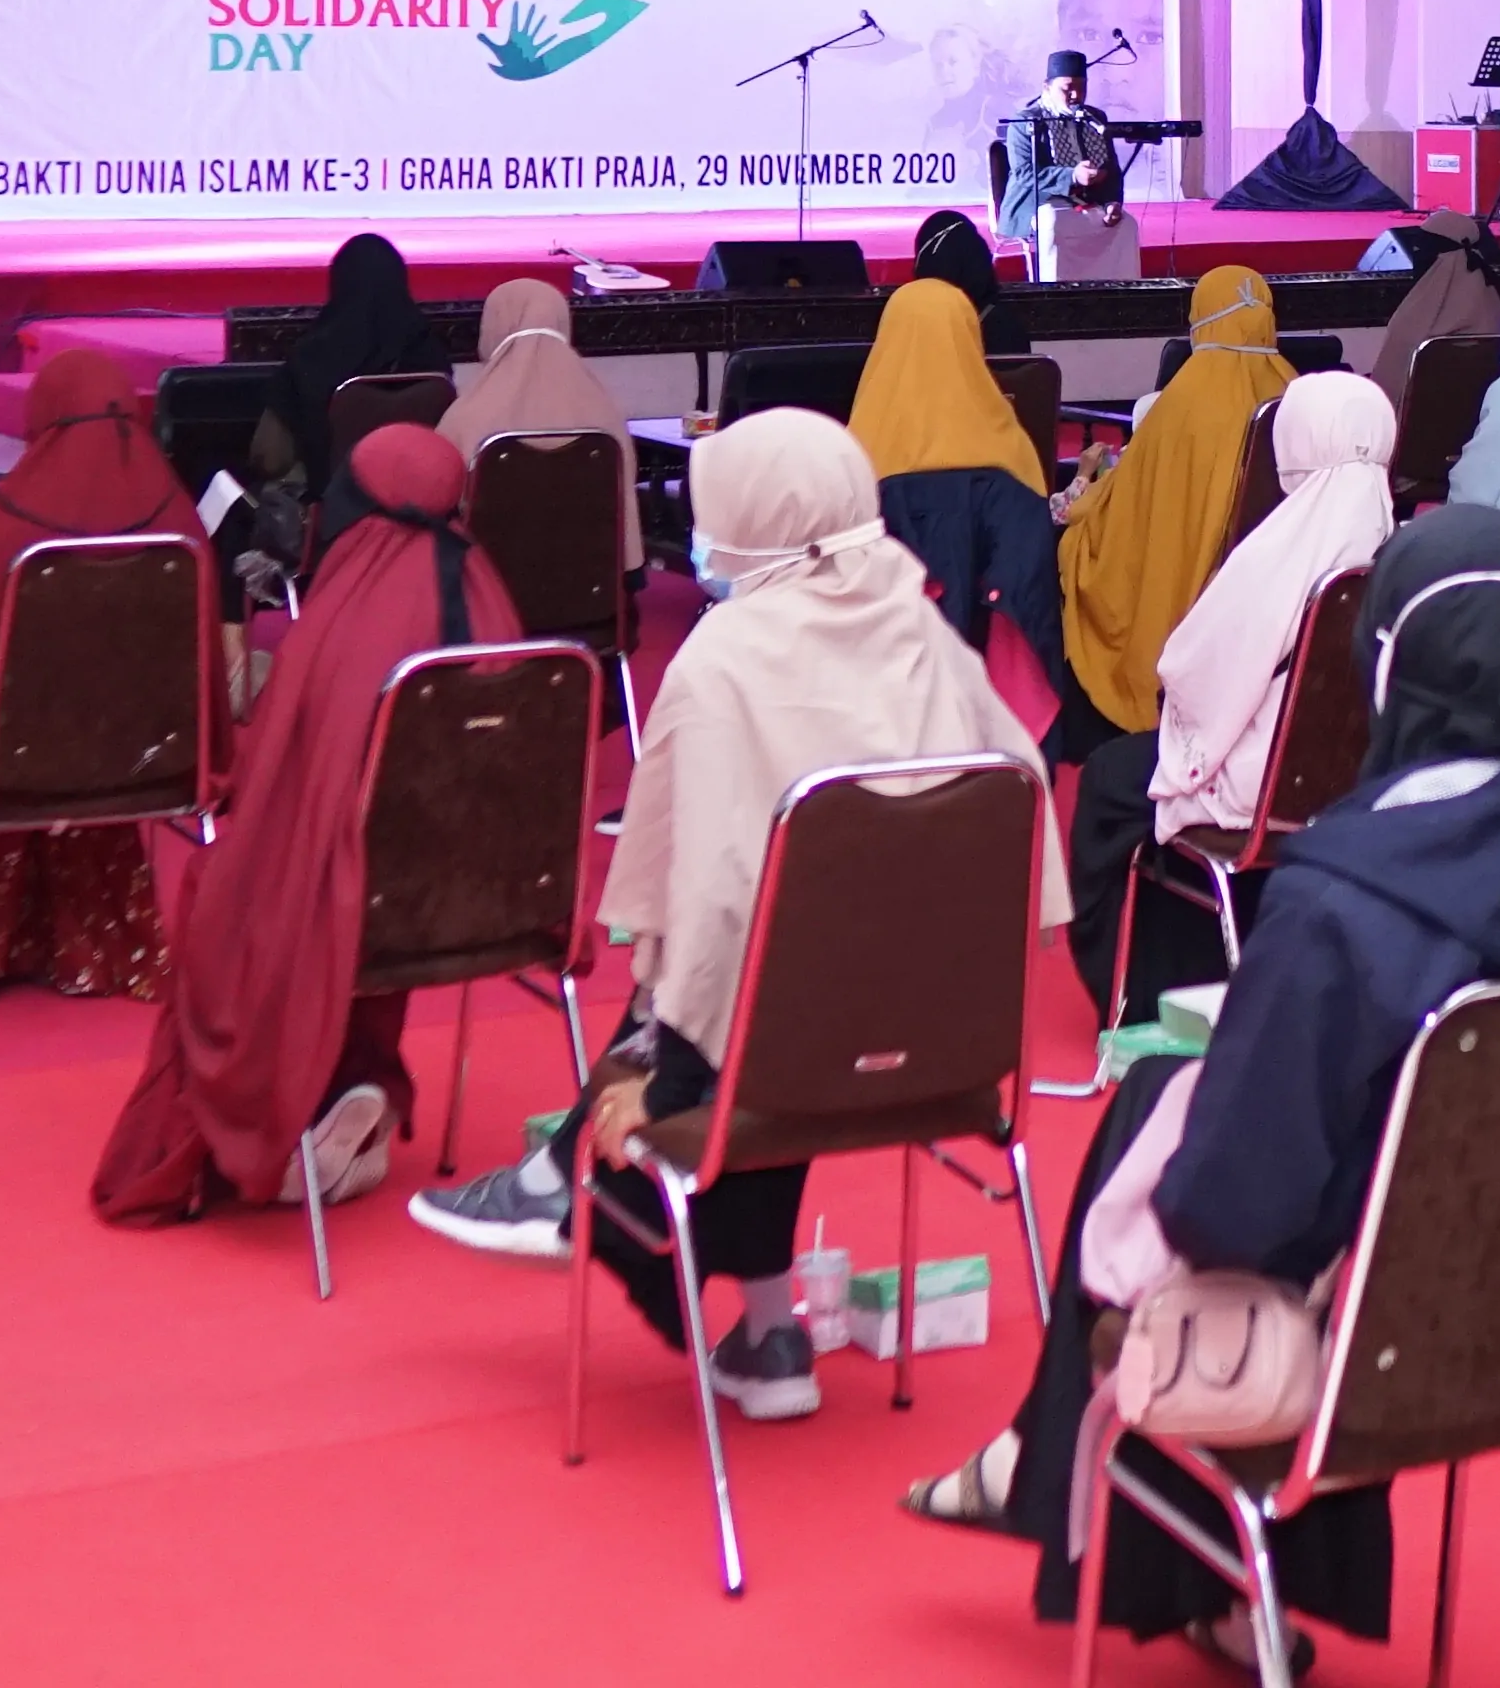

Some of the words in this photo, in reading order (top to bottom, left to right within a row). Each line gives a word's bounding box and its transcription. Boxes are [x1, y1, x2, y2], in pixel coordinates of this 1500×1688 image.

[208, 32, 314, 71] DAY
[96, 159, 186, 195] DUNIA
[199, 158, 289, 193] ISLAM
[302, 158, 370, 192] KE-3
[400, 157, 493, 191] GRAHA
[504, 156, 583, 190] BAKTI
[595, 155, 685, 192] PRAJA,
[697, 155, 728, 187] 29
[740, 153, 882, 187] NOVEMBER
[892, 152, 955, 185] 2020
